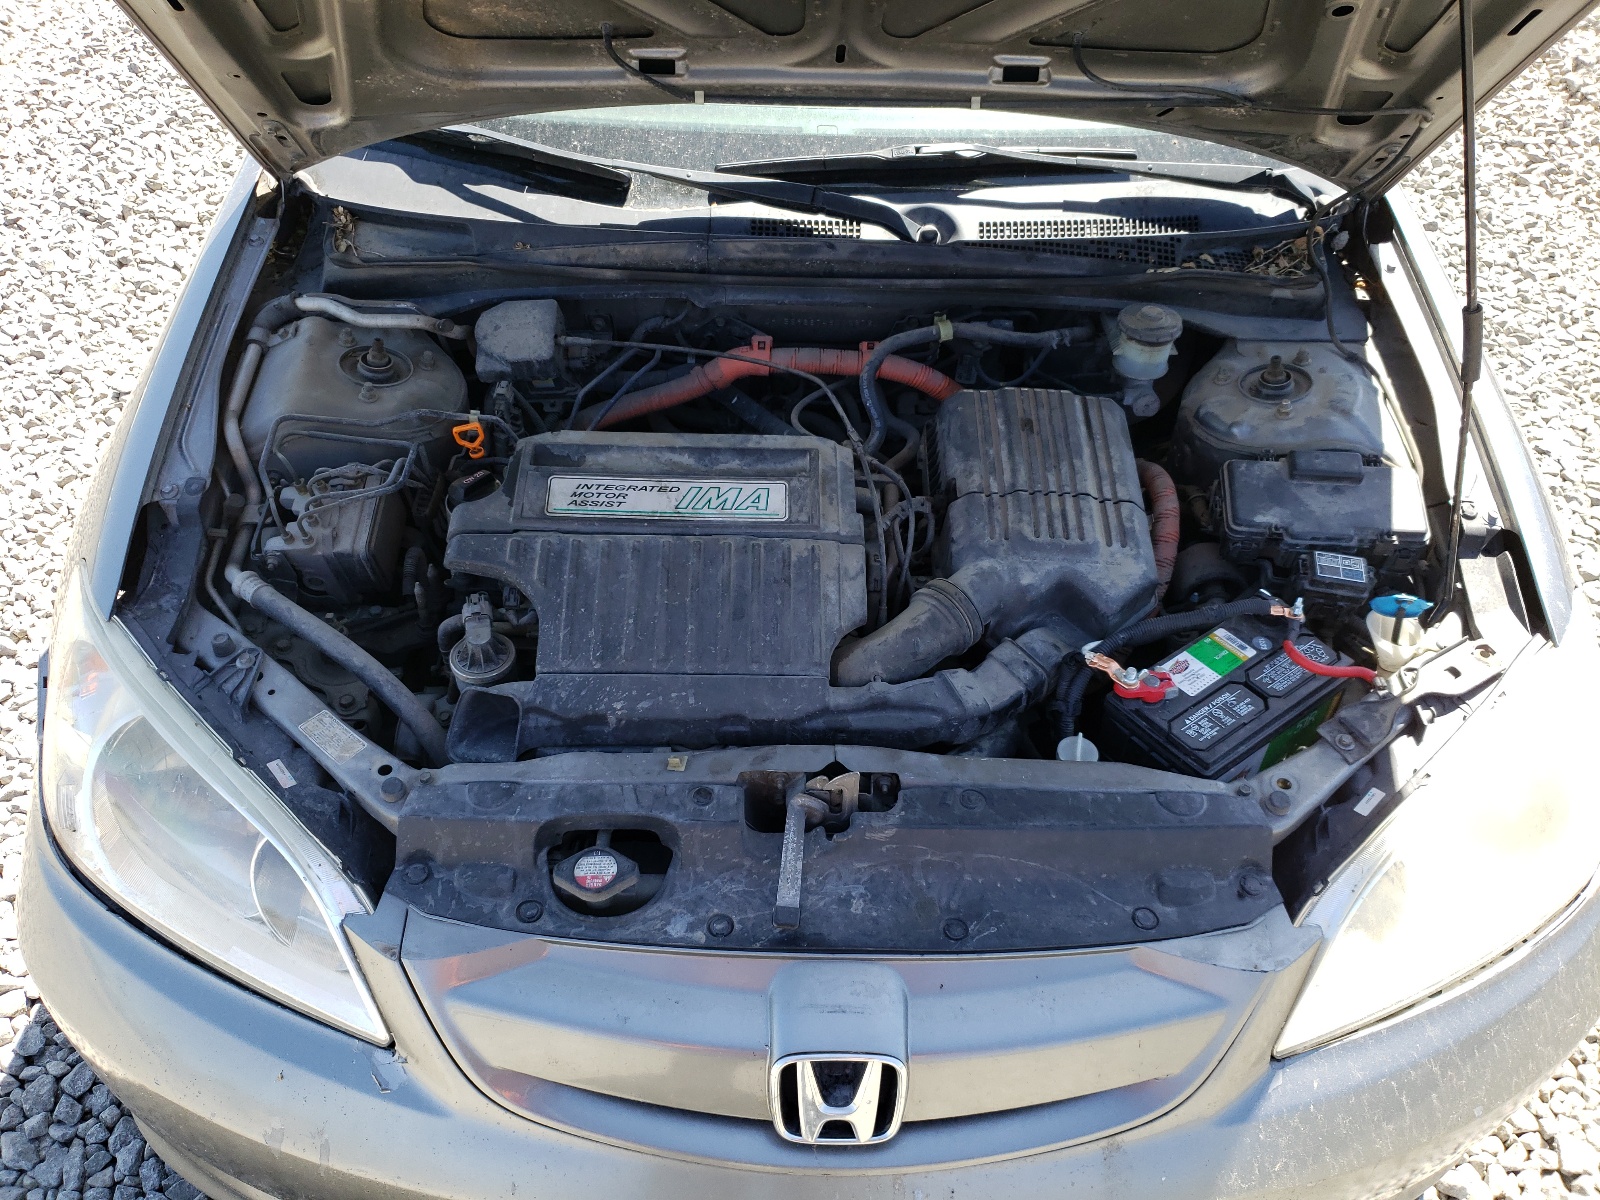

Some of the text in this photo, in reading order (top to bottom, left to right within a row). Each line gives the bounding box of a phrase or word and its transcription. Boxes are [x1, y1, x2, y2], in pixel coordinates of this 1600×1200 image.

[575, 483, 681, 493] INTEGRATED
[569, 492, 629, 500] MOTOR
[675, 486, 770, 511] IMA
[567, 499, 627, 508] ASSIST
[1189, 704, 1211, 721] DANGER
